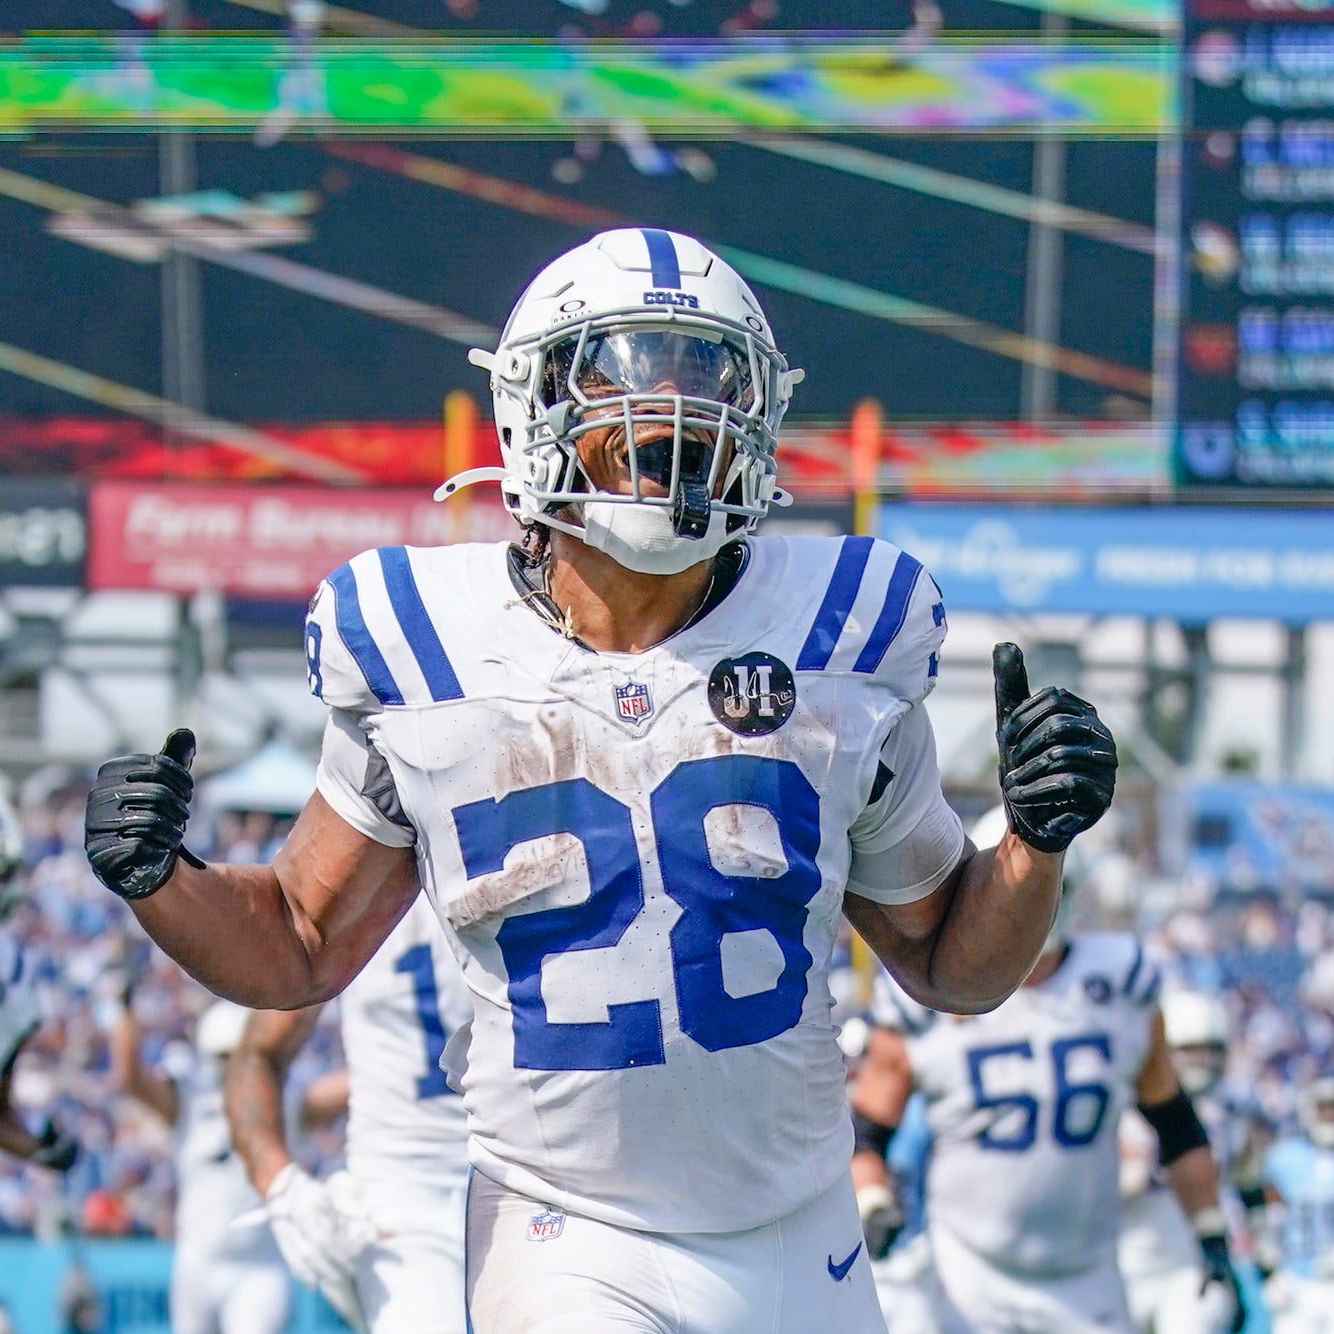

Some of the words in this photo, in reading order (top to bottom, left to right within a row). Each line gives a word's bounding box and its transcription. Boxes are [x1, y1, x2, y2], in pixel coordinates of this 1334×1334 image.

[643, 291, 699, 309] COLTS
[620, 697, 648, 716] NFL
[452, 754, 821, 1072] 28
[965, 1033, 1113, 1153] 56
[532, 1222, 557, 1237] NFL
